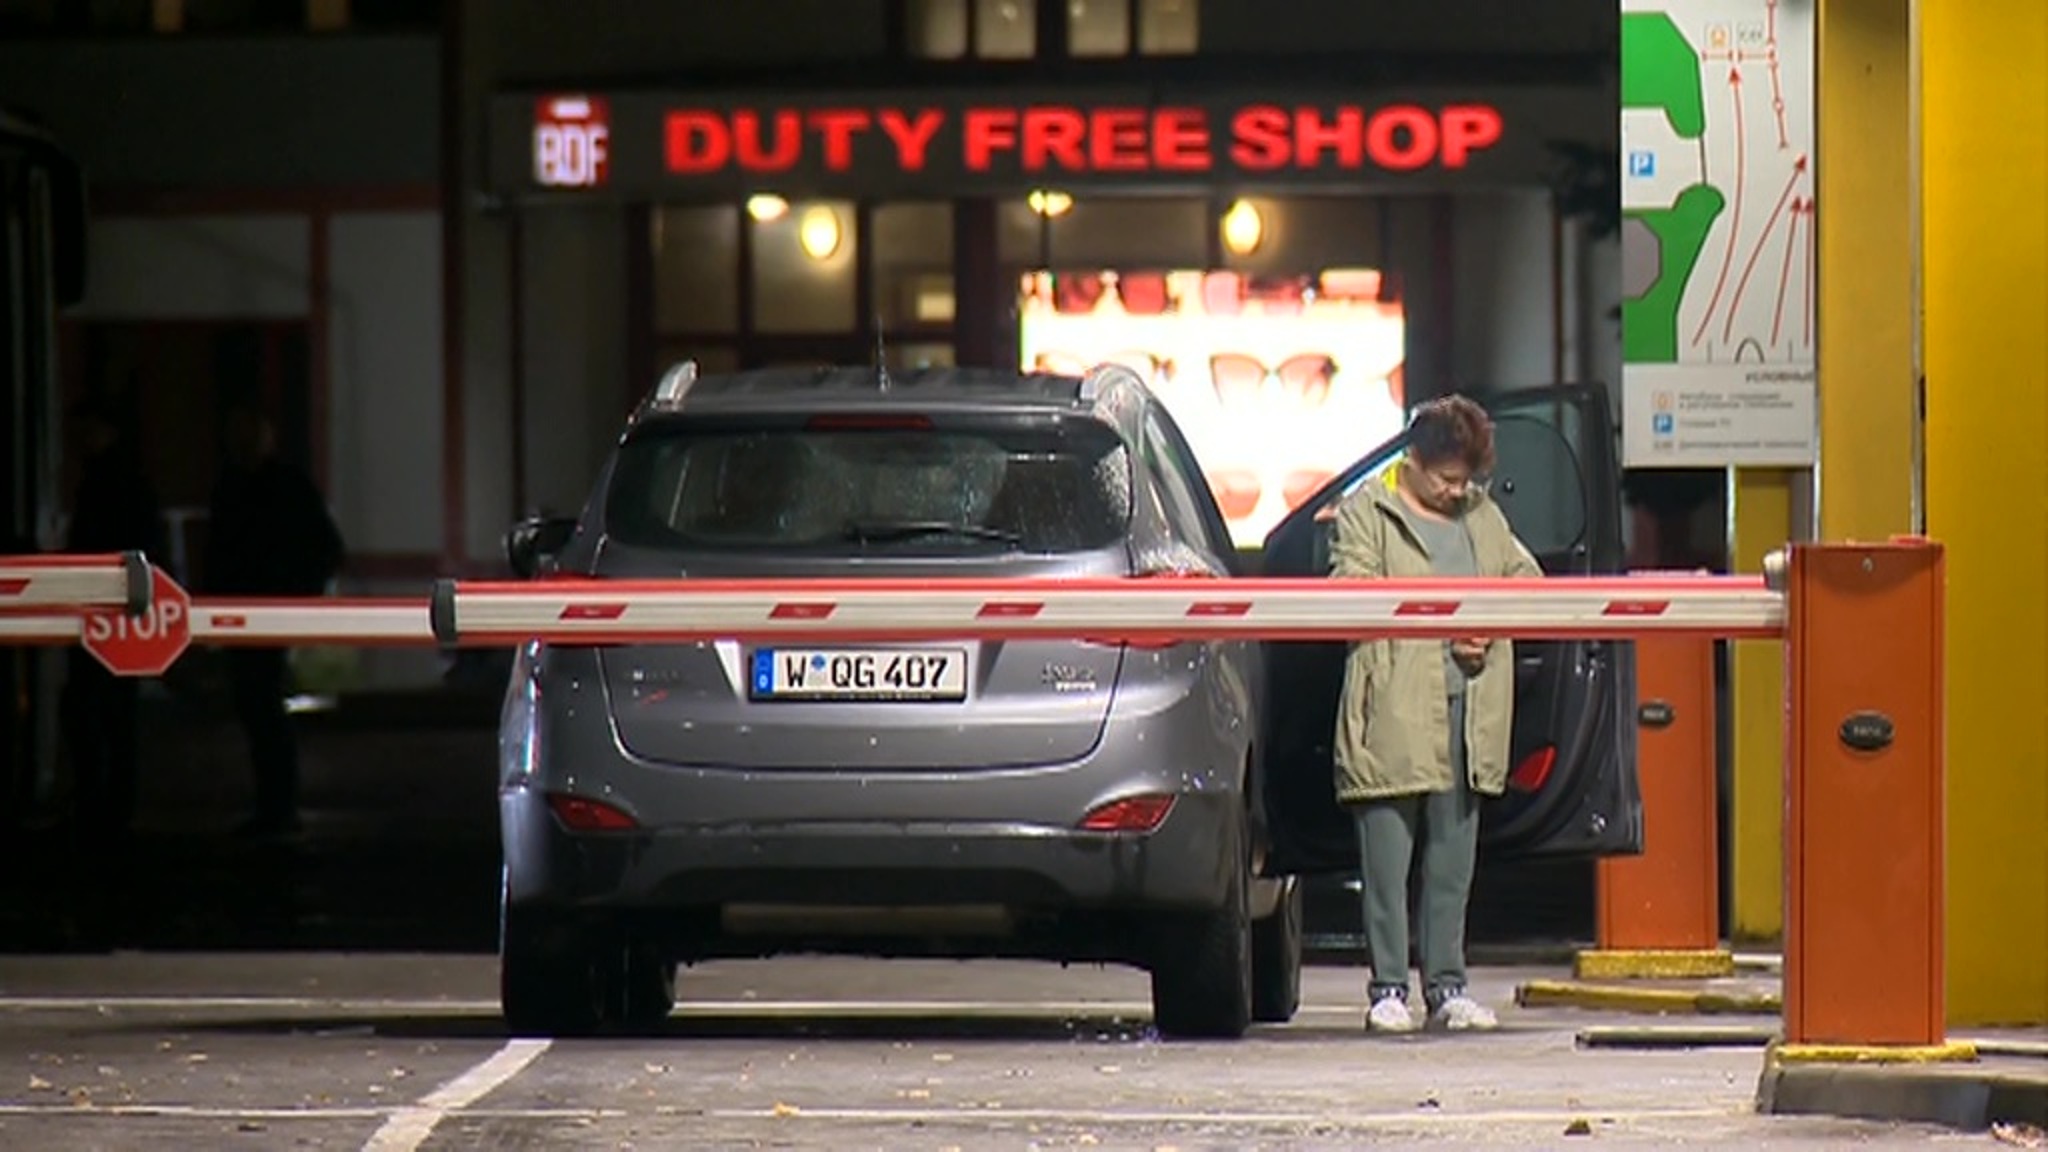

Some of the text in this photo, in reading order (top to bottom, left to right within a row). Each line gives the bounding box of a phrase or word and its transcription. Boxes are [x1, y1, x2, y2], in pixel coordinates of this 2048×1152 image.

[664, 104, 1502, 172] DUTY FREE SHOP
[786, 656, 949, 688] W QG 407
